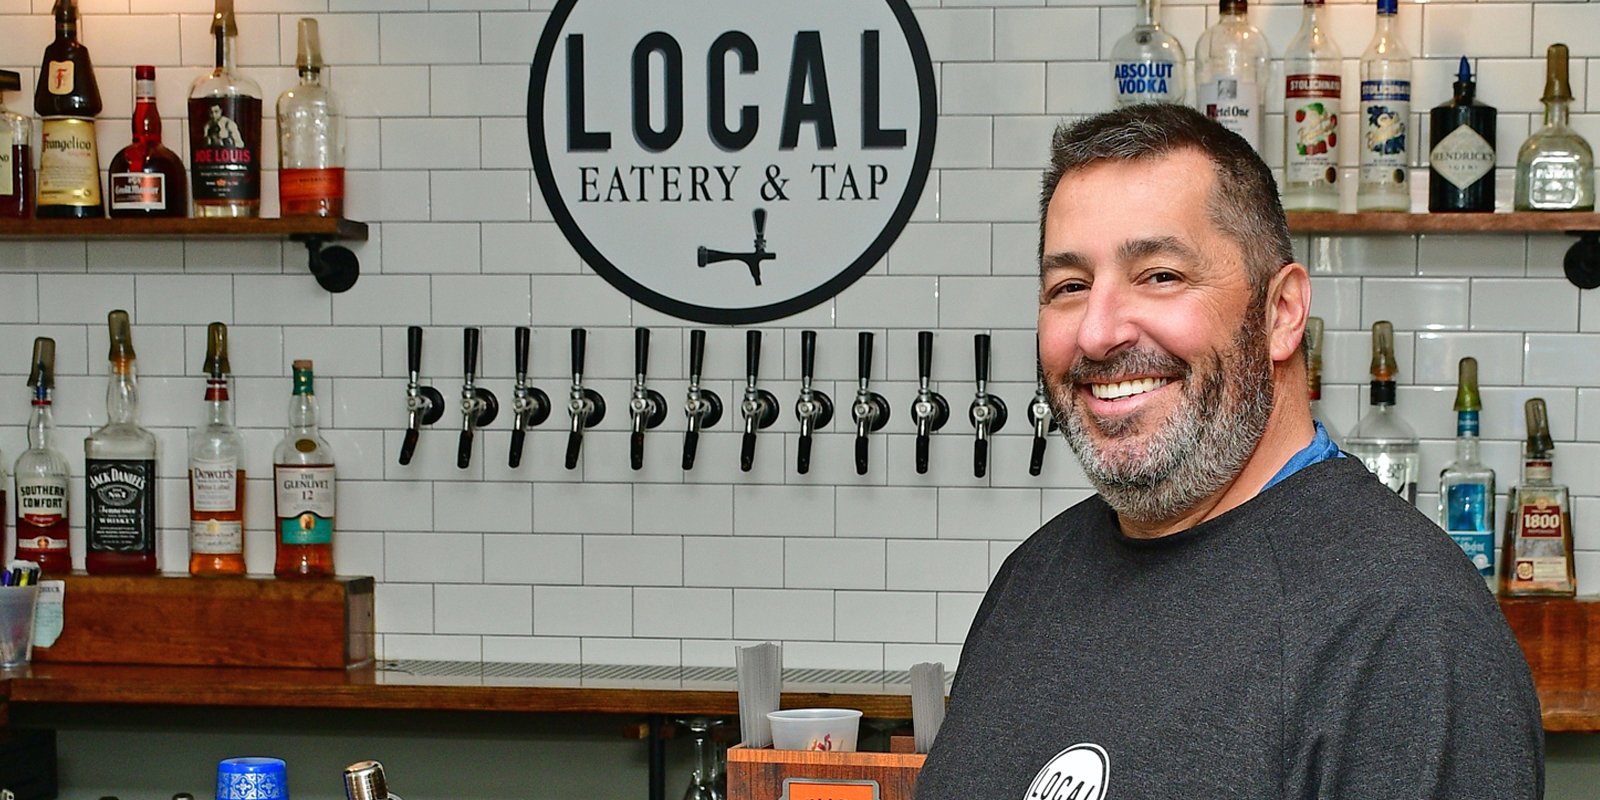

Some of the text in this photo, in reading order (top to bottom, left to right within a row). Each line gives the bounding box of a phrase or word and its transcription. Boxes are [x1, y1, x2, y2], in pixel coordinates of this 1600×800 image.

[1114, 63, 1174, 79] ABSOLUT
[565, 29, 908, 153] LOCAL
[1119, 79, 1168, 95] VODKA
[1232, 105, 1249, 118] One
[43, 133, 91, 152] Frangelico
[195, 149, 250, 163] JOE LOUIS
[578, 162, 889, 202] EATERY & TAP
[90, 467, 146, 490] JACK DANIEL'S
[283, 480, 328, 490] GLENLIVET
[20, 485, 64, 497] SOUTHERN
[301, 490, 313, 500] 12
[23, 498, 62, 508] COMFORT
[1524, 513, 1560, 529] 1800
